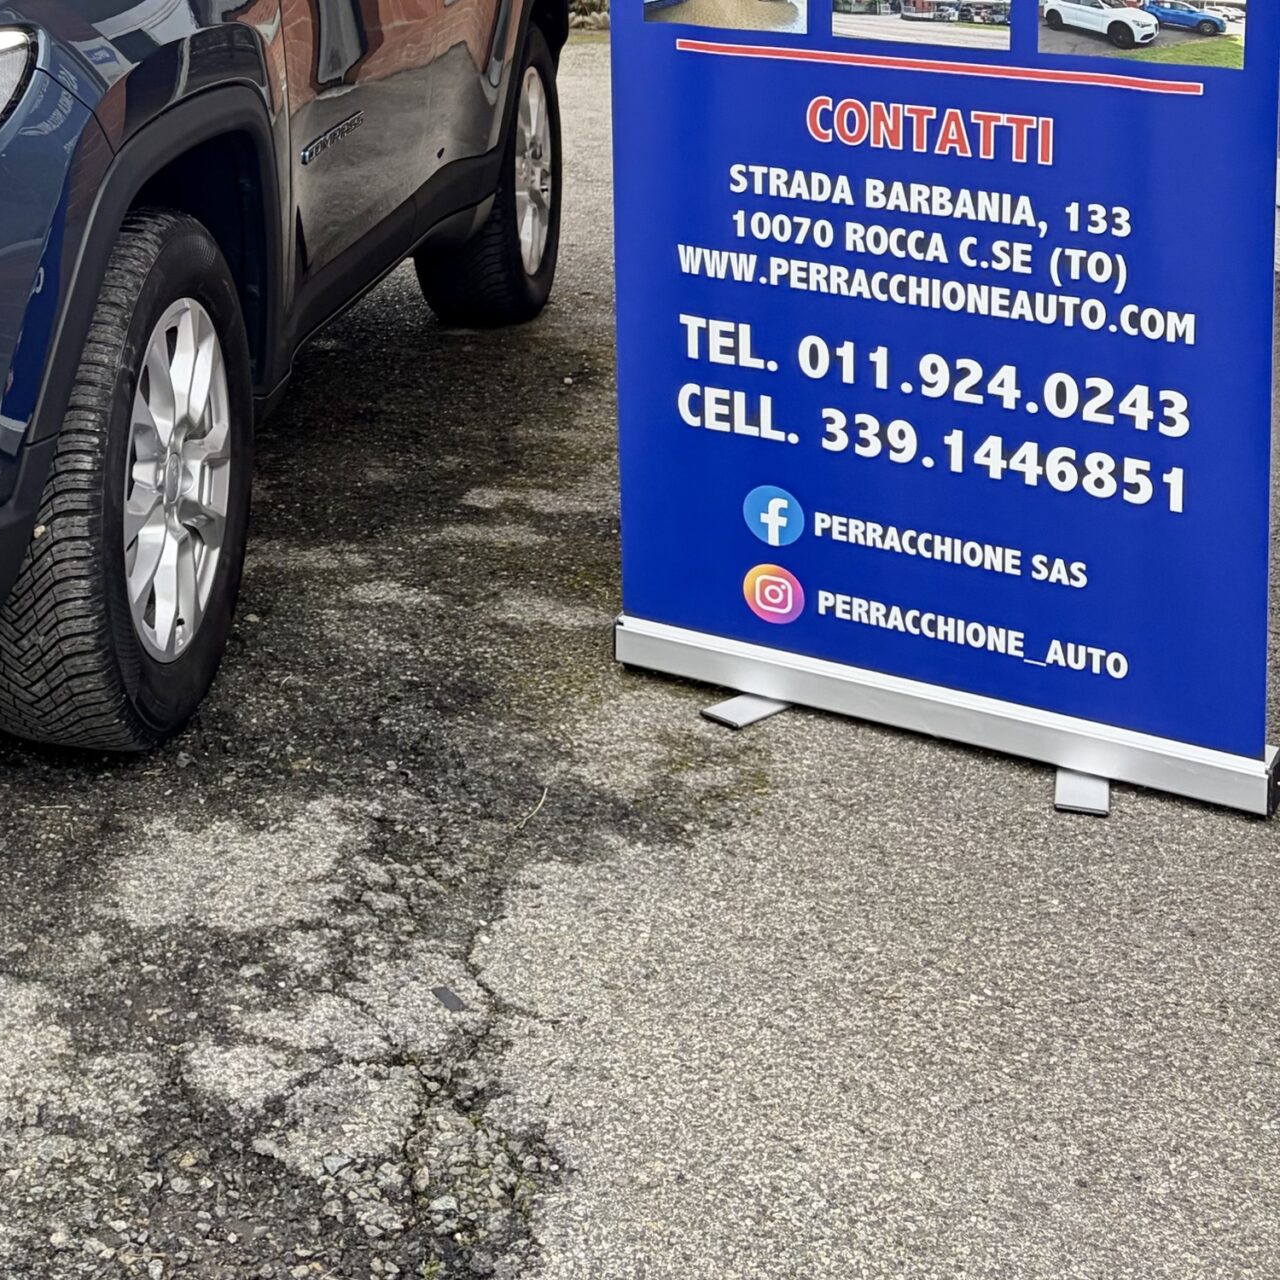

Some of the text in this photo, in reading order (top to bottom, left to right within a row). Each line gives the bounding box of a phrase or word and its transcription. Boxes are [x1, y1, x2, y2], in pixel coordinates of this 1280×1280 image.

[806, 95, 1054, 166] CONTATTI
[729, 163, 1131, 238] STRADA BARBANIA, 133
[677, 244, 1196, 345] WWW.PERRACCHIONEAUTO.COM
[732, 209, 1128, 294] 10070 ROCCA C.SE (TO)
[679, 313, 1190, 438] TEL. 011.924.0243
[677, 383, 1184, 513] CELL. 339.1446851
[814, 511, 1088, 588] PERRACCHIONE SAS
[818, 590, 1128, 679] PERRACCHIONE_AUTO
